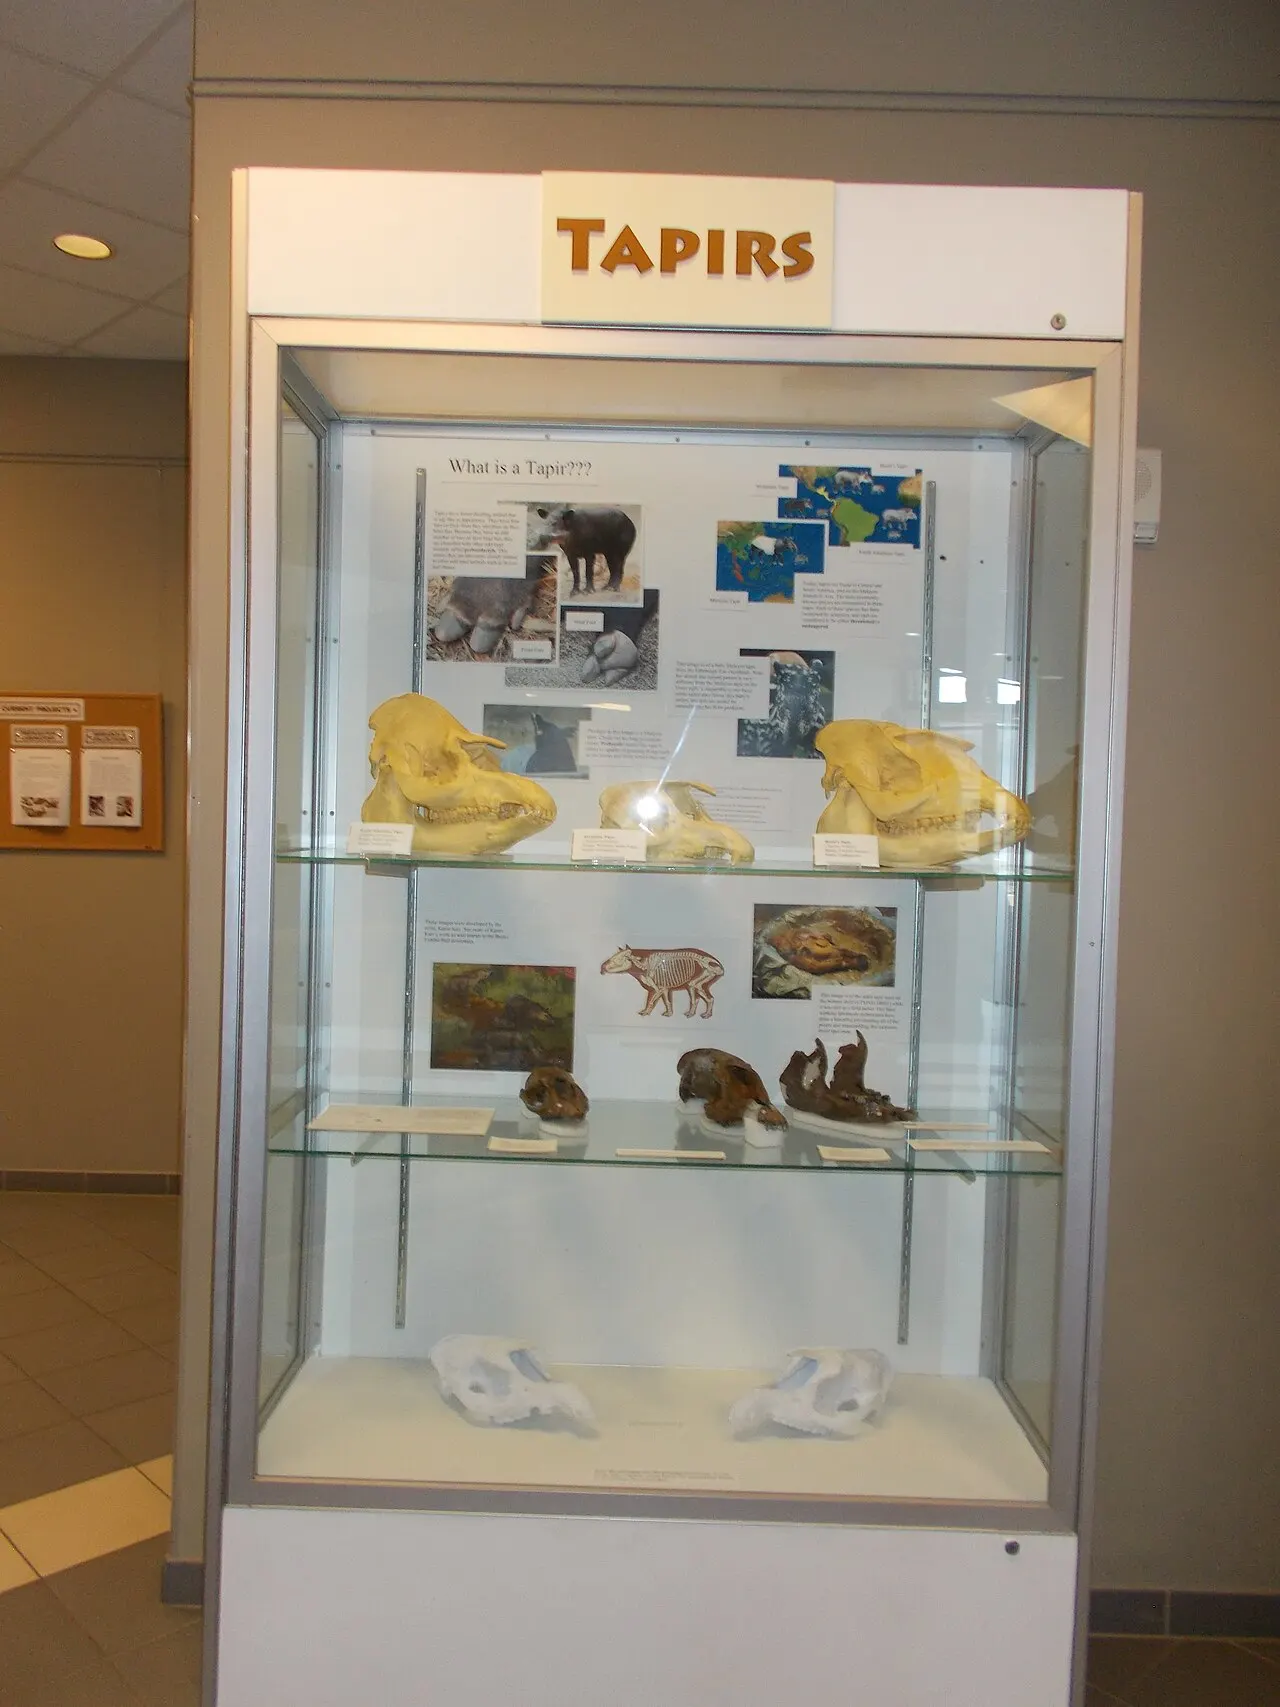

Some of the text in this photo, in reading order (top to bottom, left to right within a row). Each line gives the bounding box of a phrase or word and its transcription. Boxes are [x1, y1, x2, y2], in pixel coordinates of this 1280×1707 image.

[556, 217, 815, 279] TAPIRS
[449, 457, 592, 479] What is a Tapir???
